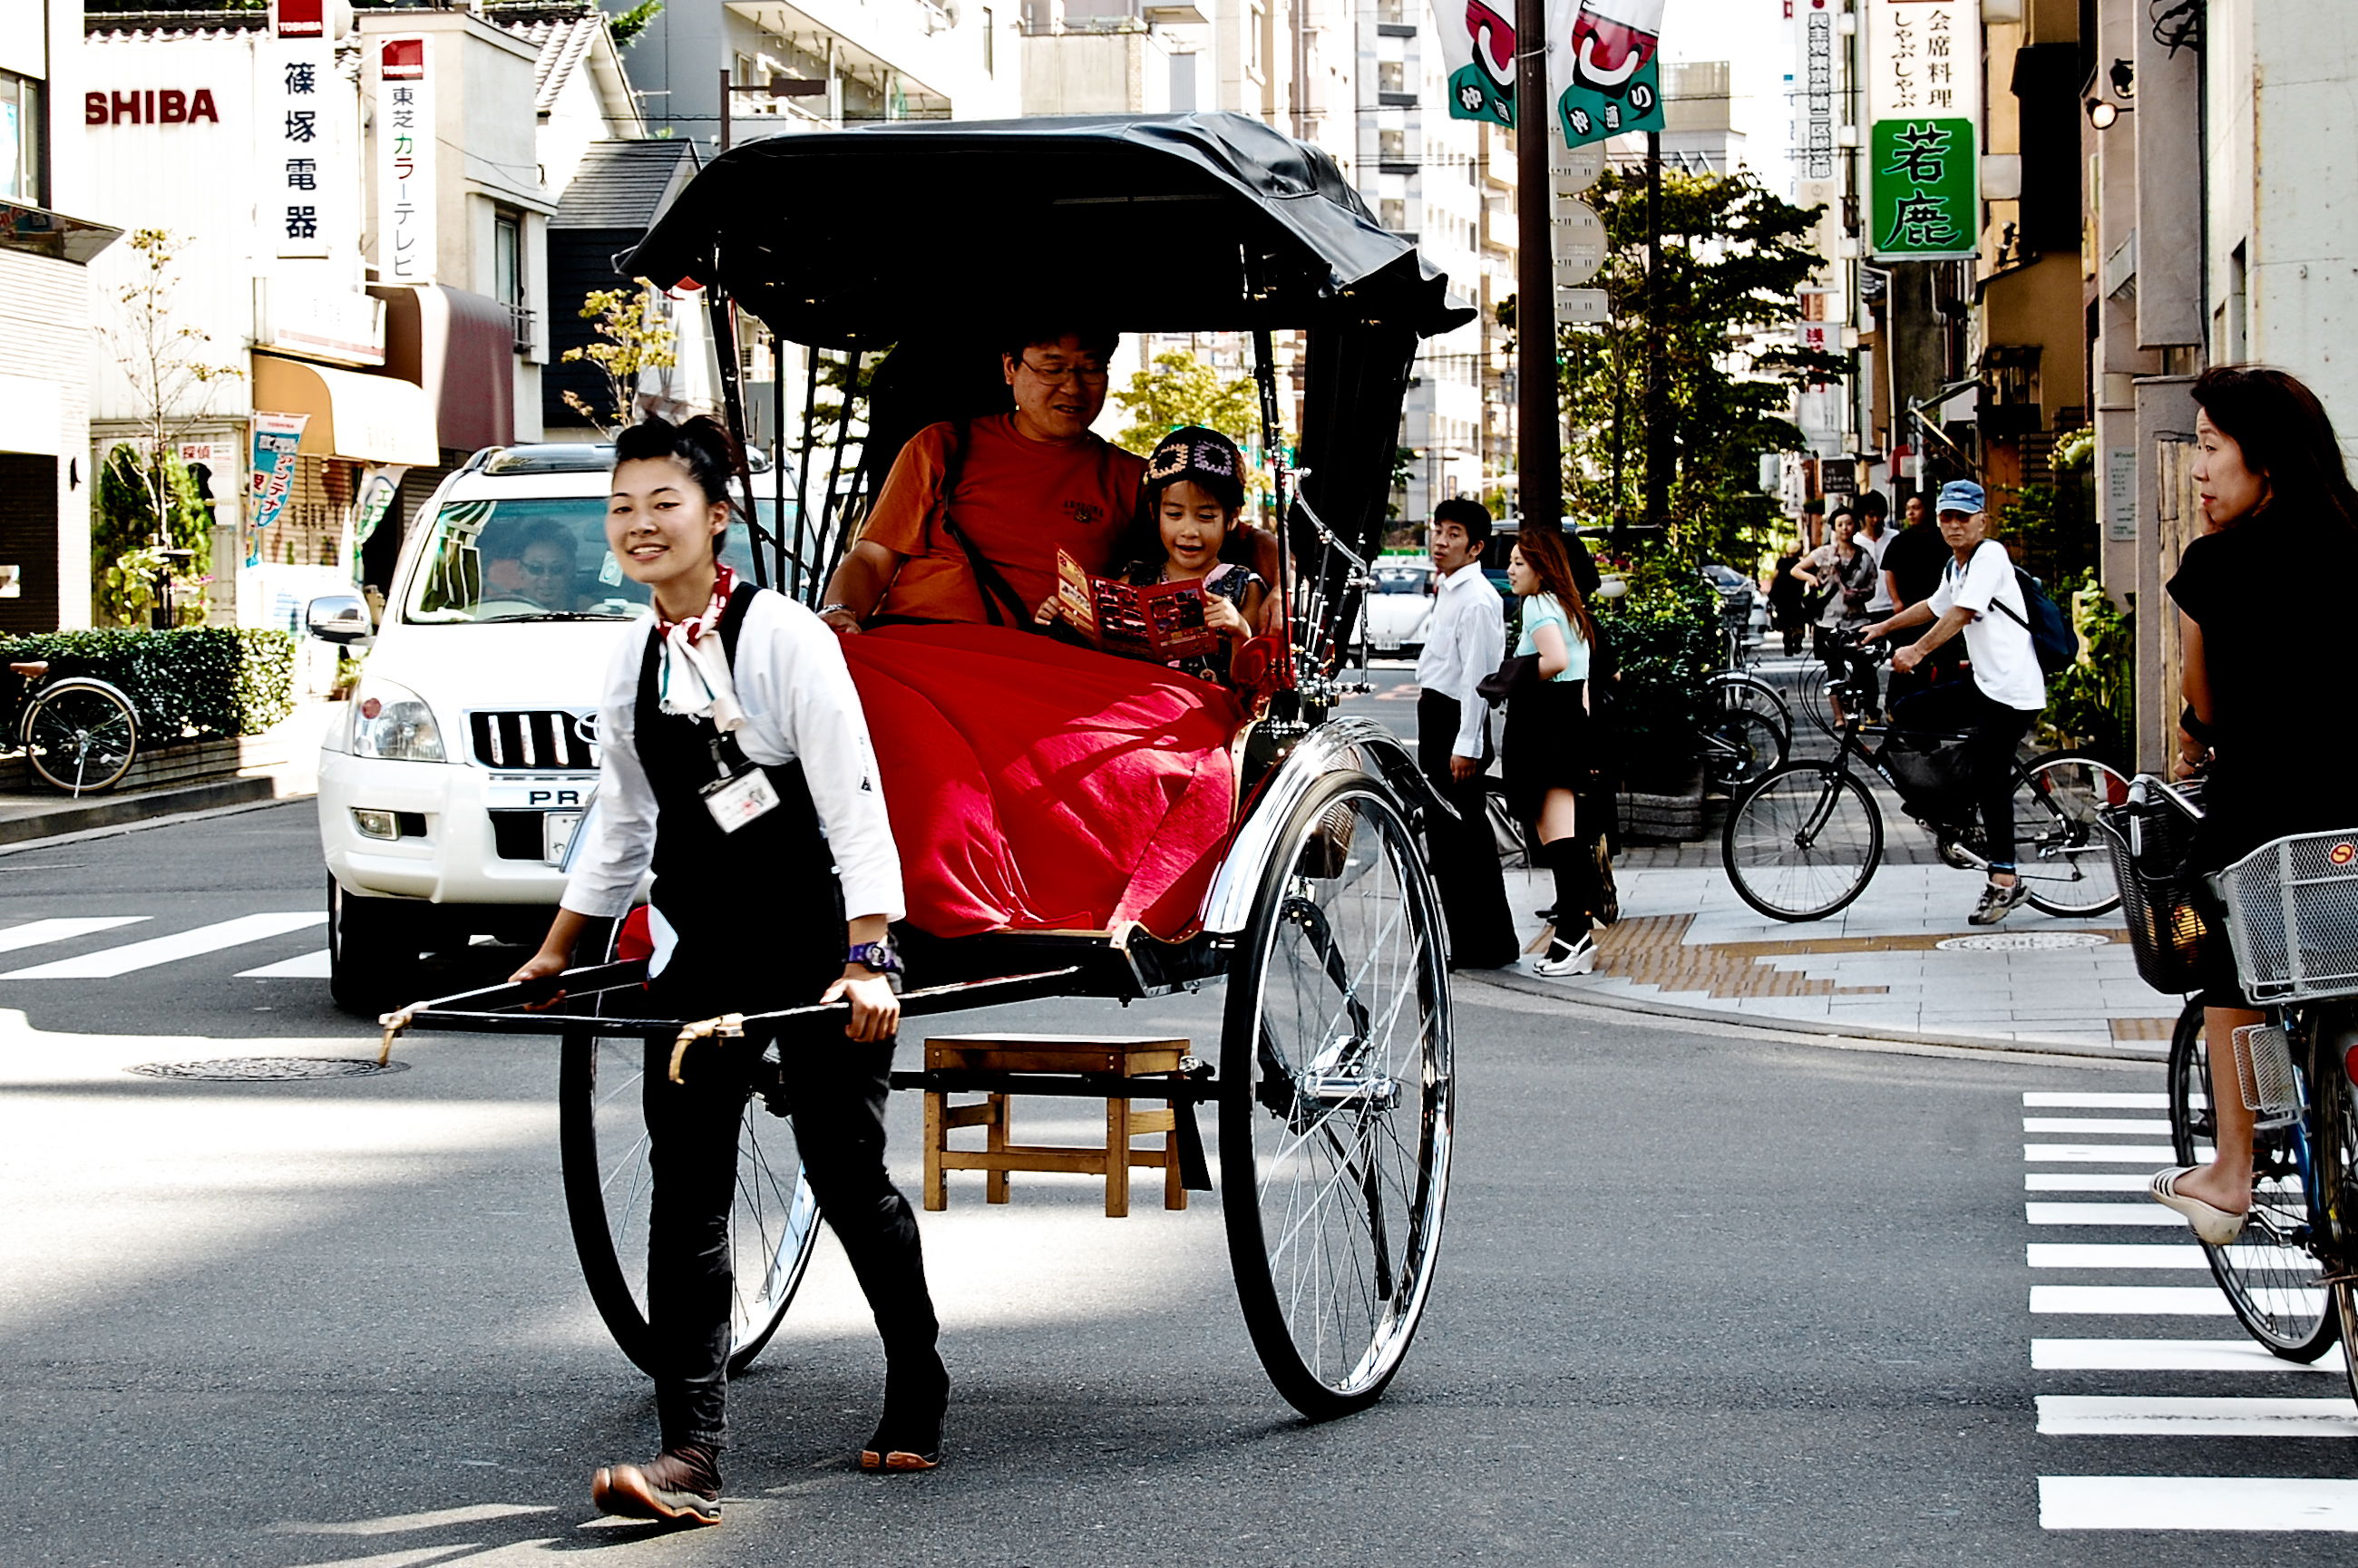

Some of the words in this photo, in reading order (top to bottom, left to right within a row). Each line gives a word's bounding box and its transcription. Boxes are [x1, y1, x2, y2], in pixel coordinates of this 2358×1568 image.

[279, 22, 322, 32] TOSHIBA
[1891, 11, 1916, 108] しゃぶしゃぶ
[1928, 10, 1953, 108] 会席料理
[85, 89, 219, 124] SHIBA
[285, 62, 317, 239] 篠塚電器
[392, 87, 415, 277] 東芝カラーテレビ
[1881, 122, 1962, 248] 若鹿
